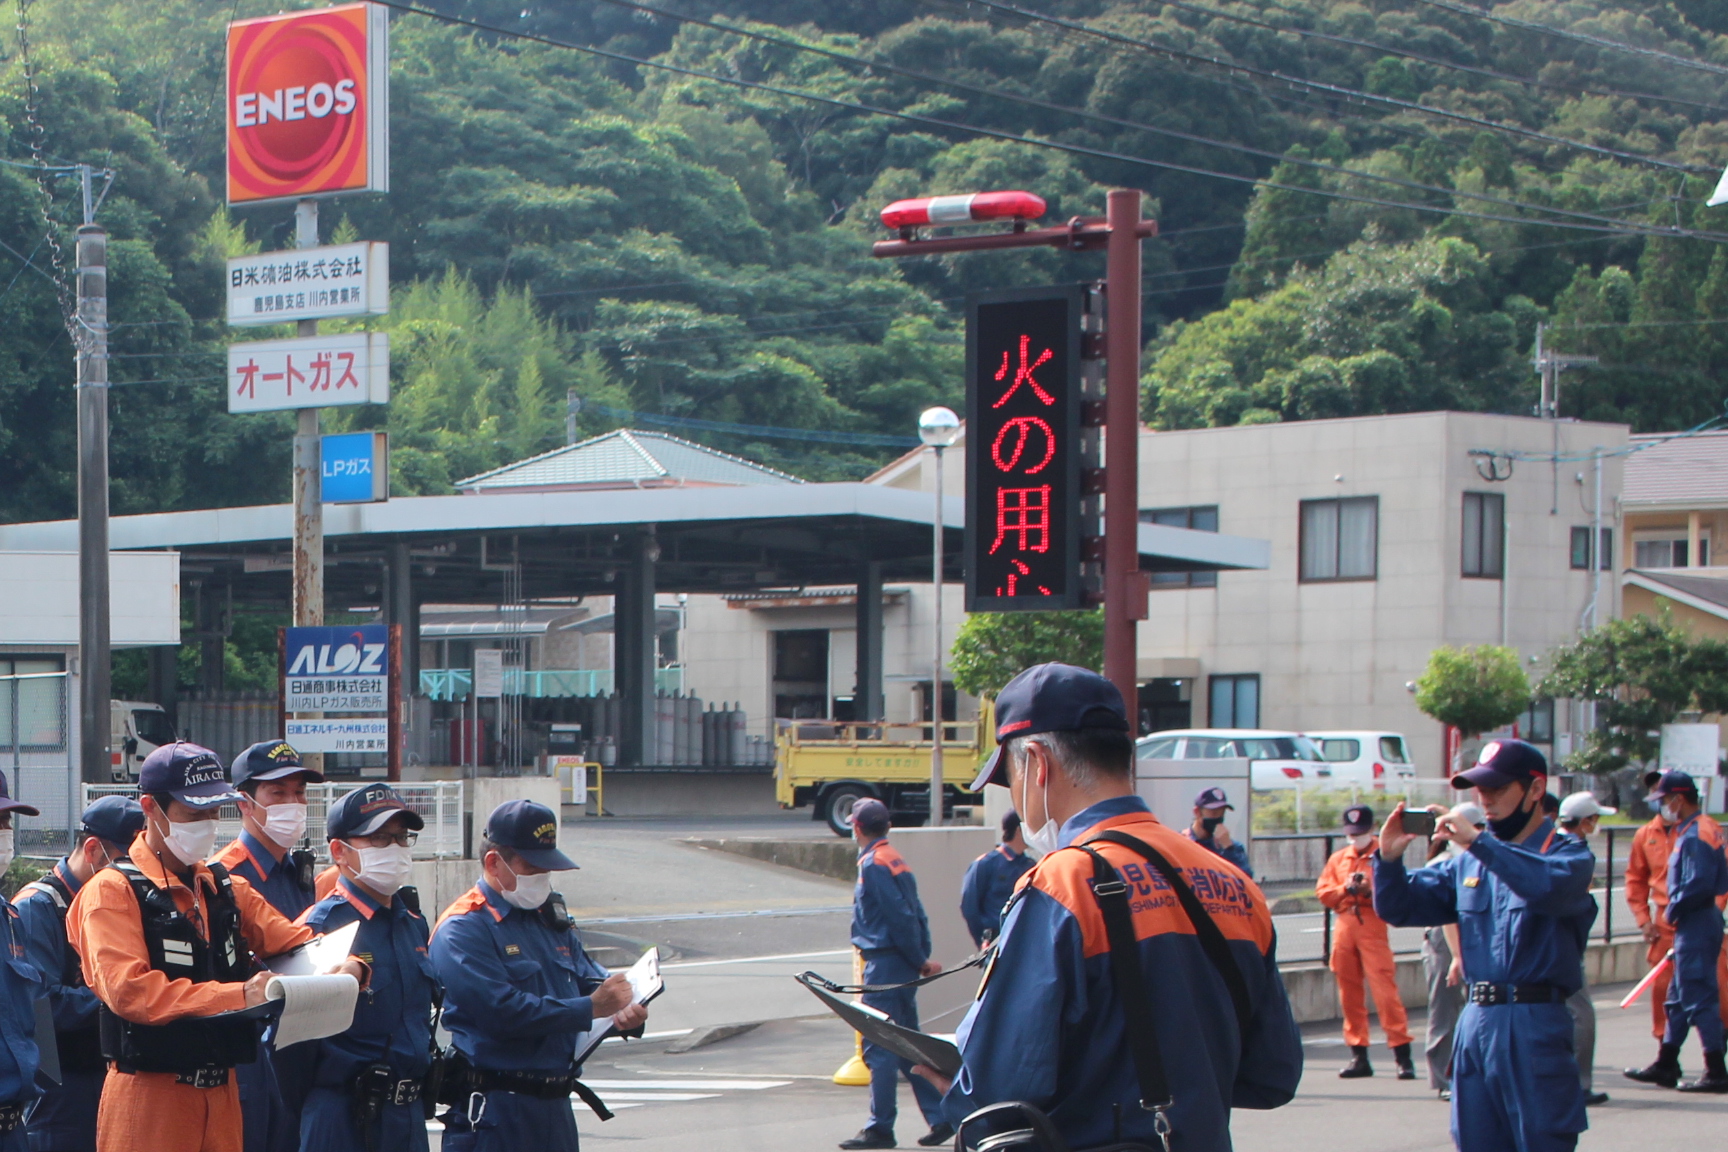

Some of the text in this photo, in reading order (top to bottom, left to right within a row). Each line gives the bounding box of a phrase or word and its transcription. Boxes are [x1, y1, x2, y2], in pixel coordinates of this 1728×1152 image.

[235, 78, 356, 128] ENEOS
[236, 352, 359, 399] オートガス
[323, 459, 371, 478] LPガス
[292, 679, 382, 694] 日通商事株式会社
[287, 724, 386, 734] 日通エネルギー九州株式会社
[336, 739, 386, 750] 川内営業所
